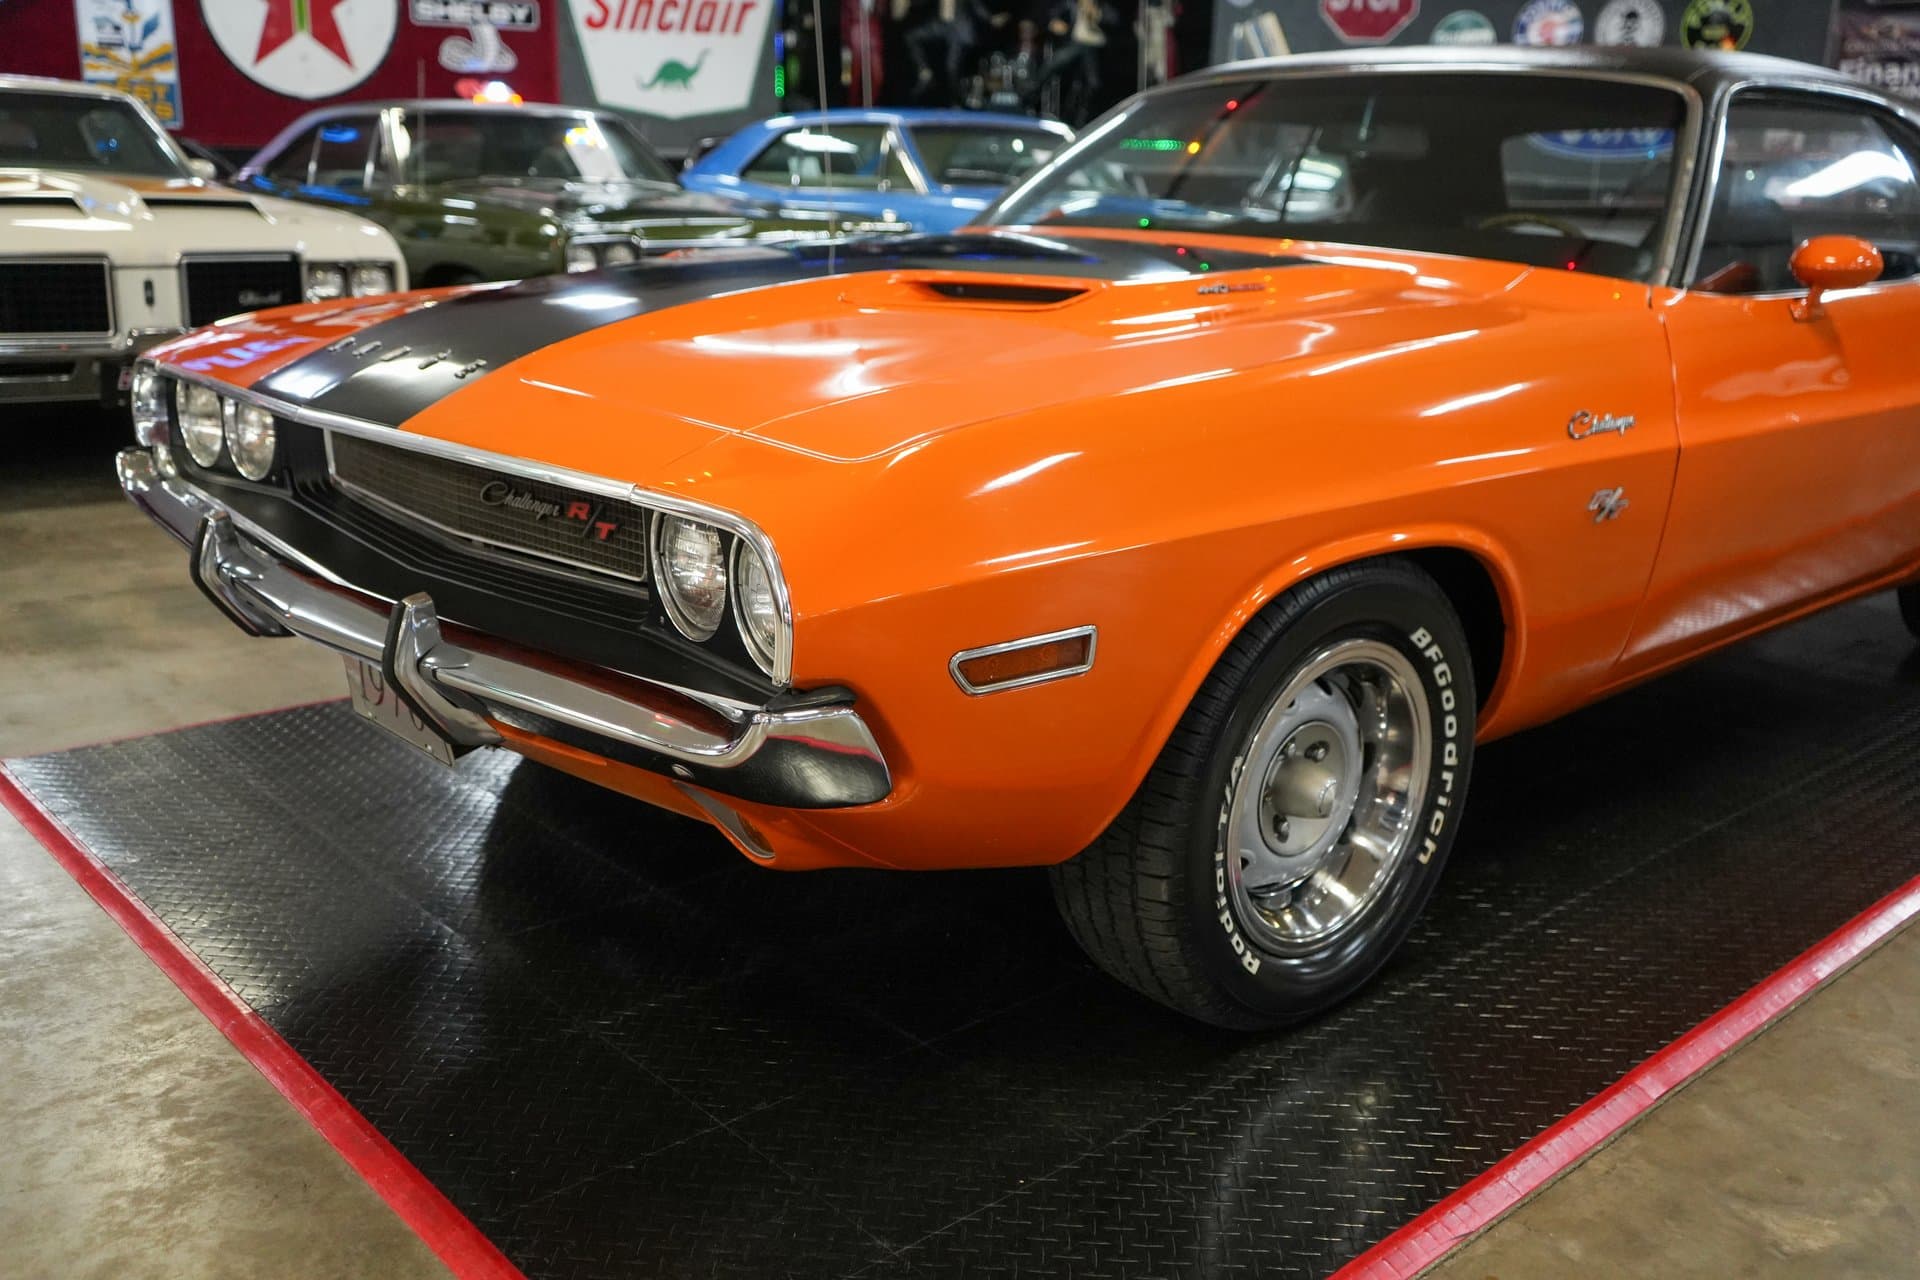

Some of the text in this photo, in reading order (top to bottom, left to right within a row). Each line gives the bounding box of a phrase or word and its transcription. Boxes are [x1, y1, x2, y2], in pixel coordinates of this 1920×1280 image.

[584, 0, 757, 33] Sinclair
[479, 481, 617, 541] Challenger R/T
[1409, 626, 1458, 866] BFGoodrich
